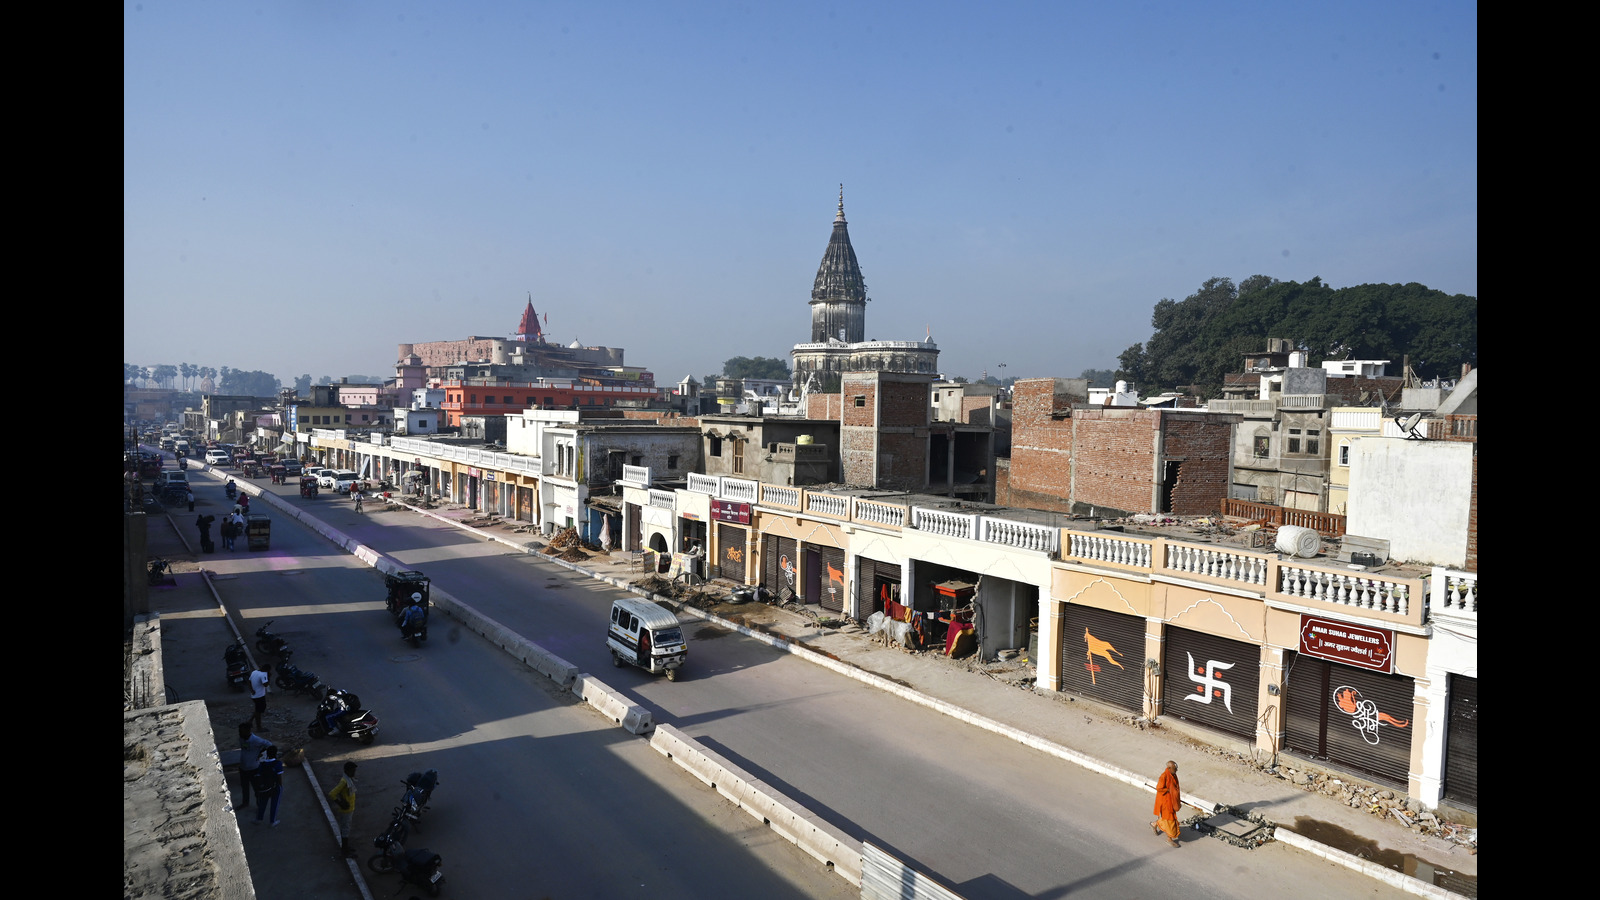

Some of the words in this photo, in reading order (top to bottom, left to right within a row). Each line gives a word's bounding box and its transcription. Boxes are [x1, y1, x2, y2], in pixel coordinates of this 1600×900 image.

[1312, 625, 1328, 635] AMAR
[1328, 628, 1347, 638] SUHAG
[1347, 632, 1380, 645] JEWELLERS
